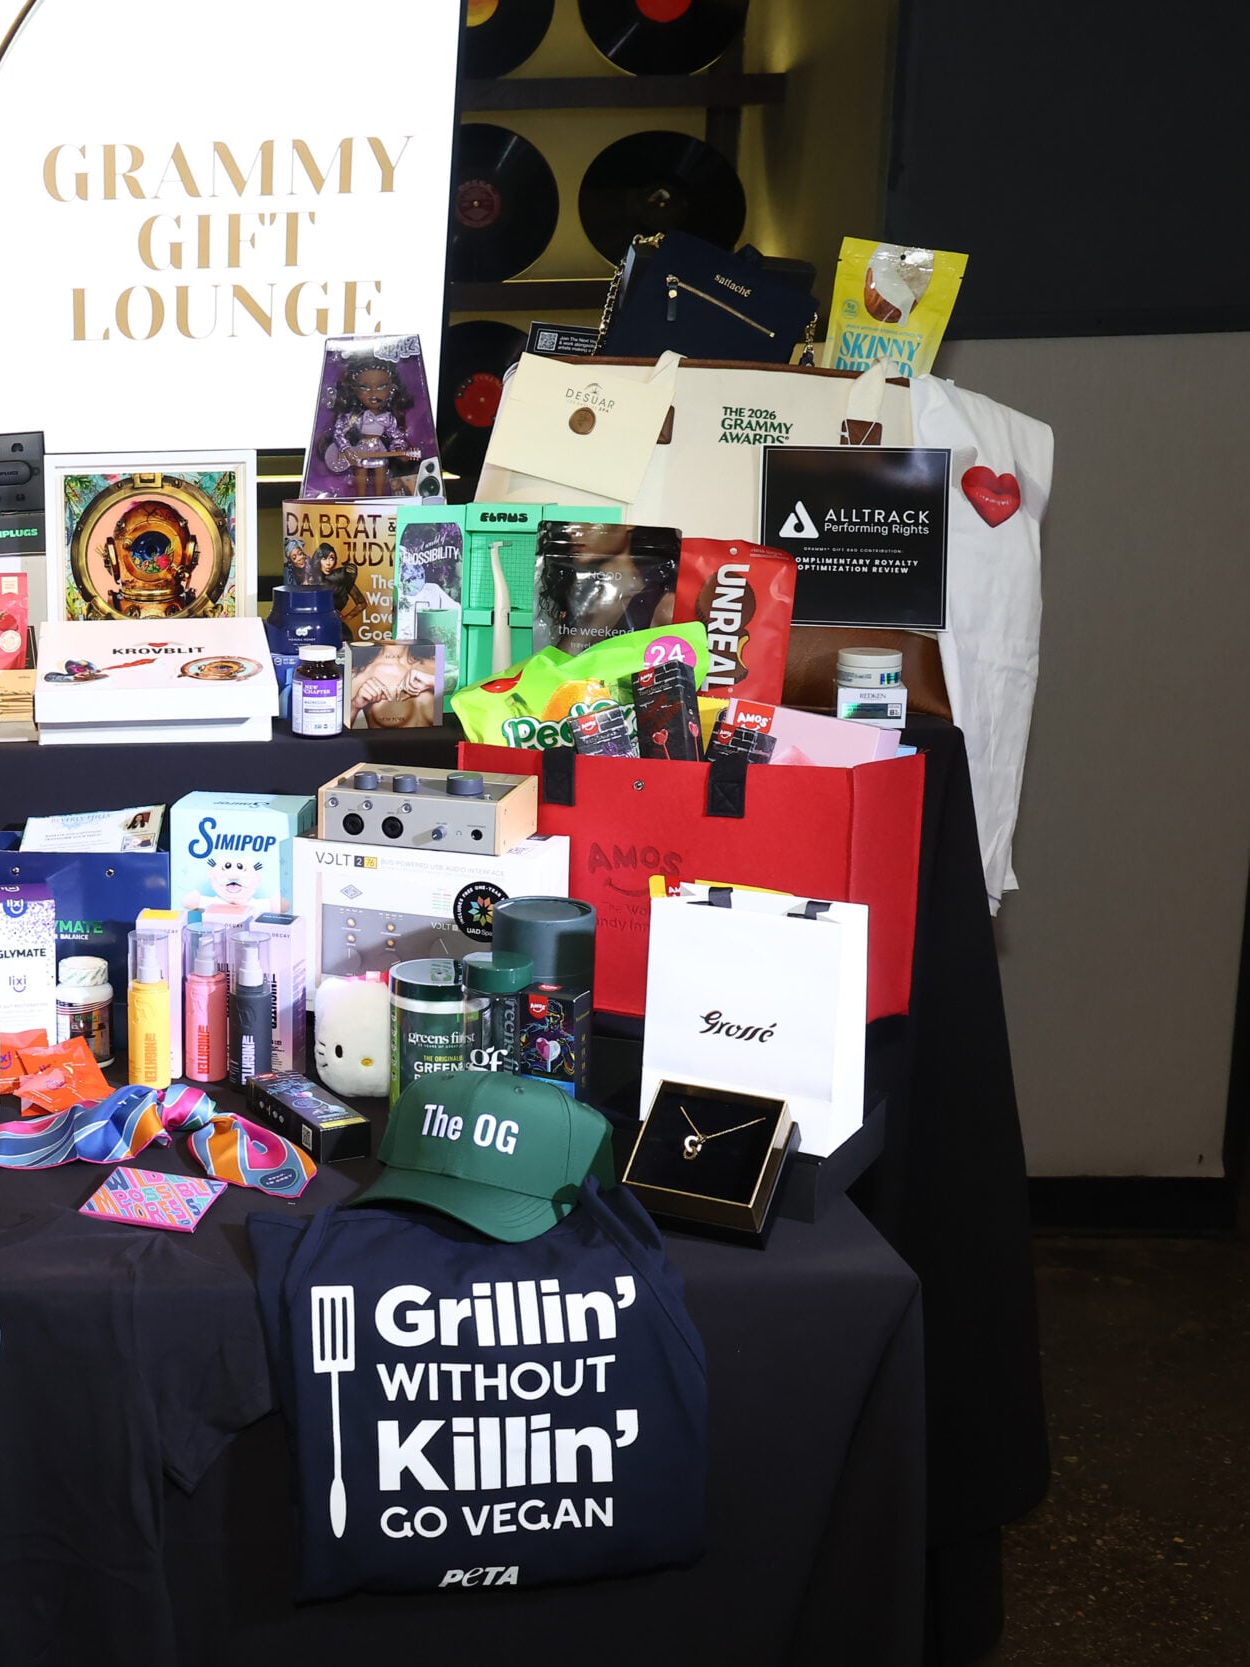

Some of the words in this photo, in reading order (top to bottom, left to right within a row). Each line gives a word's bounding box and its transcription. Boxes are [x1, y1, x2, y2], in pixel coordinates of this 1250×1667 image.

[43, 135, 414, 203] GRAMMY
[137, 211, 316, 271] GIFT
[70, 280, 382, 341] LOUNGE
[840, 331, 921, 362] SKINNY
[565, 388, 615, 410] DESUAR
[722, 406, 746, 418] THE
[748, 408, 776, 420] 2026
[721, 418, 793, 435] GRAMMY
[286, 512, 314, 538] DA
[319, 513, 382, 539] BRAT
[825, 508, 930, 524] ALLTRACK
[825, 522, 889, 536] Performing
[892, 523, 930, 536] Rights
[341, 541, 396, 567] JUDY
[795, 557, 871, 565] OMPLIMENTARY
[874, 559, 919, 567] ROYALTY
[797, 564, 868, 573] OPTIMIZATION
[872, 566, 909, 574] REVIEW
[370, 574, 394, 589] The
[558, 625, 577, 636] the
[700, 563, 750, 692] UNREAL
[112, 646, 205, 655] KROVBLIT
[650, 643, 686, 667] 24
[737, 711, 768, 727] AMOS
[188, 817, 277, 859] SIMIPOP
[315, 851, 352, 867] VOLT
[356, 857, 363, 866] 2
[366, 858, 376, 867] 76
[588, 842, 682, 877] AMOS
[431, 921, 451, 931] VOLT
[9, 975, 27, 986] lixi
[408, 1031, 450, 1045] greens
[699, 1010, 778, 1044] Grossé
[421, 1103, 463, 1141] The
[472, 1112, 520, 1155] OG
[374, 1275, 637, 1347] Grillin'
[376, 1354, 617, 1402] WITHOUT
[377, 1409, 639, 1491] Killin'
[380, 1505, 448, 1538] GO
[461, 1497, 614, 1536] VEGAN
